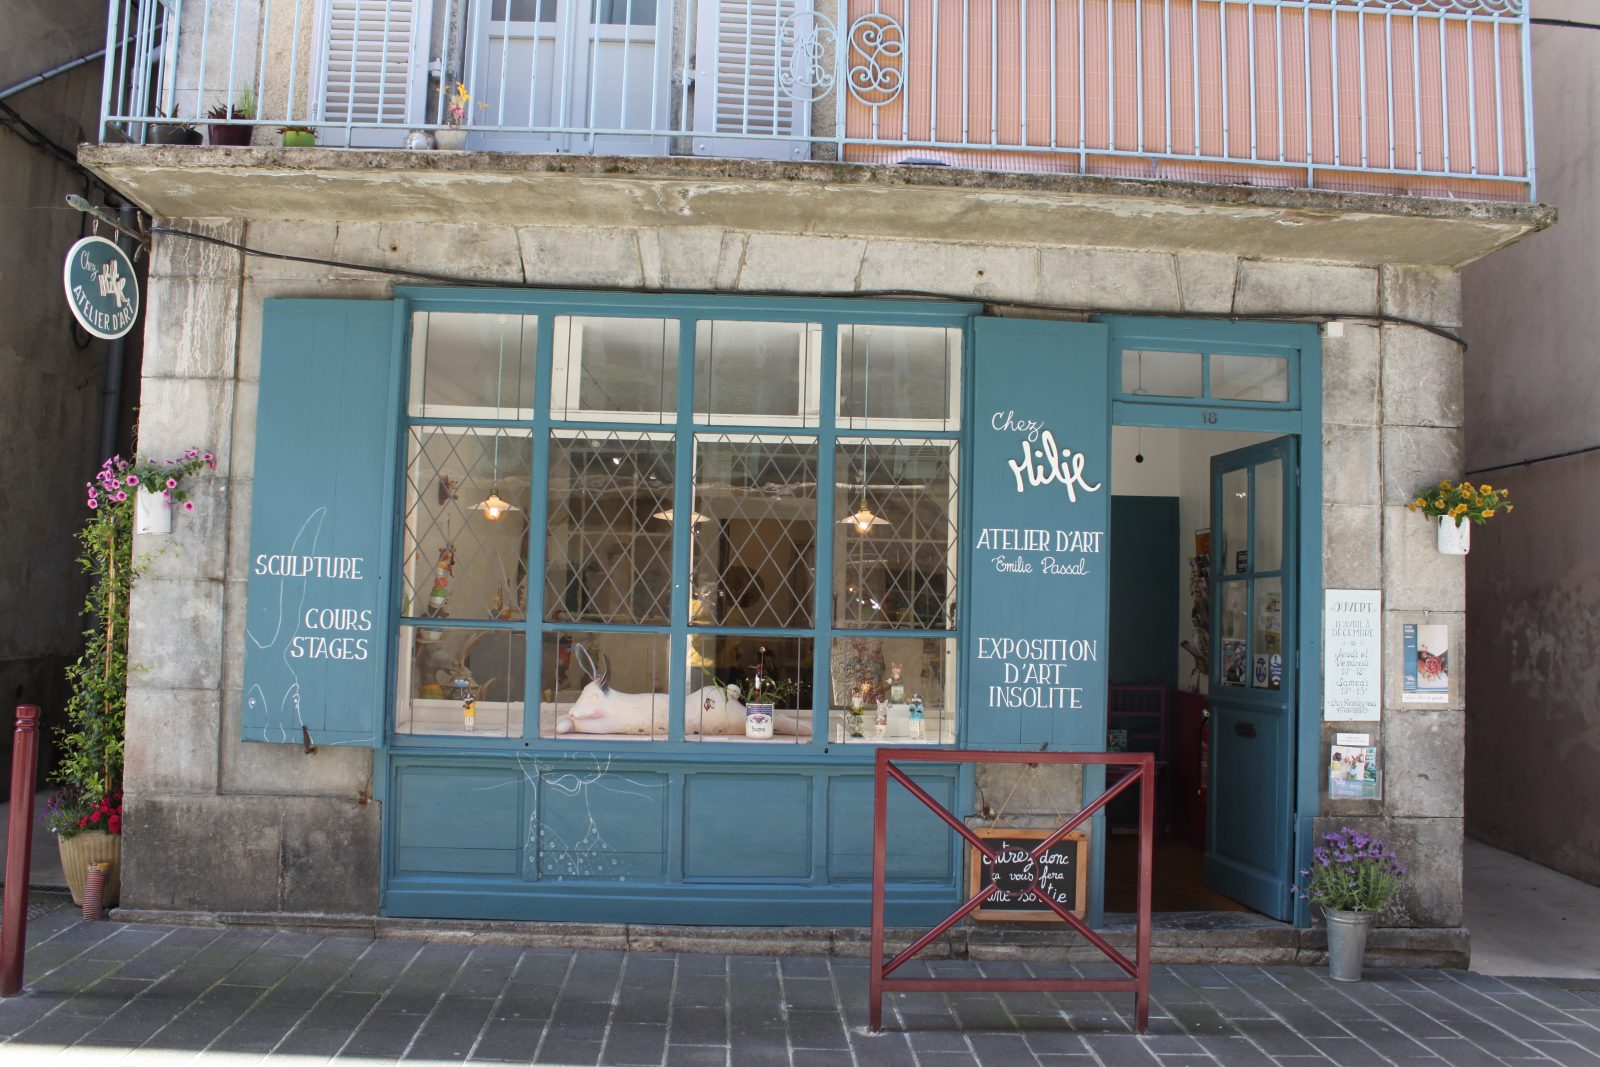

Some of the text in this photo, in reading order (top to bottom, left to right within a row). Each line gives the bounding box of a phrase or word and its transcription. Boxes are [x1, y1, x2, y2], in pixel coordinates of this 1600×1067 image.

[80, 251, 98, 281] Chez
[73, 285, 134, 331] ATELIER D'ART
[992, 411, 1044, 442] Chez
[976, 529, 1103, 552] ATELIER D'ART
[255, 554, 364, 580] SCULPTURE
[1041, 556, 1090, 576] Passal
[305, 608, 372, 631] COURS
[290, 636, 368, 660] STAGES
[977, 637, 1097, 661] EXPOSITION
[1004, 662, 1067, 685] D'ART
[989, 686, 1083, 709] INSOLITE
[1039, 849, 1069, 865] donc
[1009, 872, 1034, 881] vous
[1039, 865, 1064, 889] fera
[1018, 882, 1068, 903] sotie
